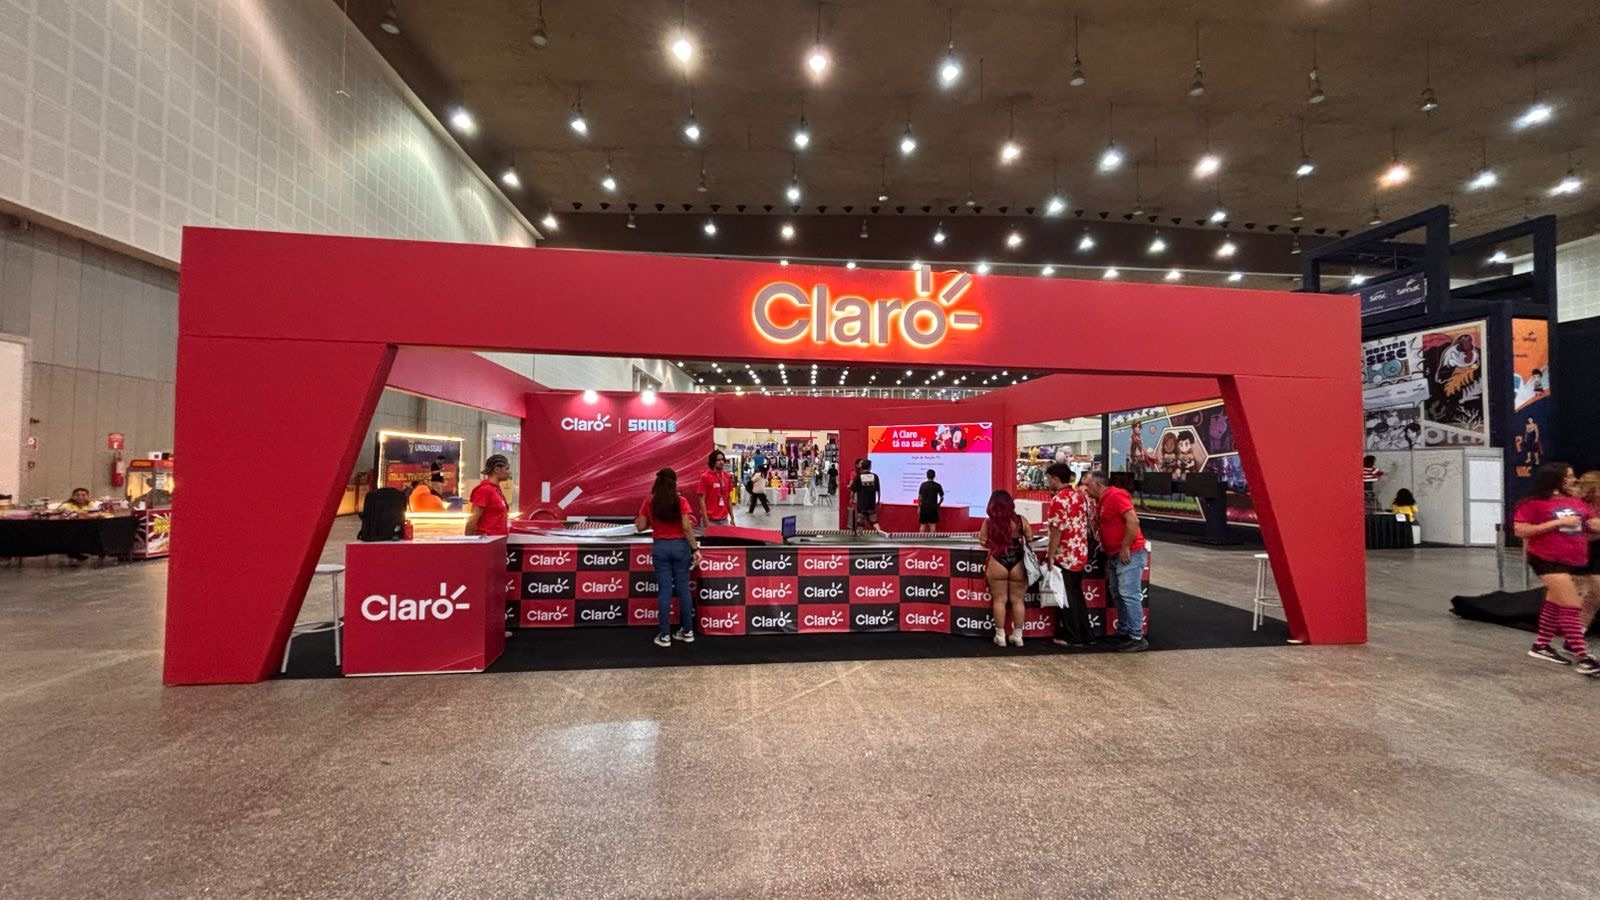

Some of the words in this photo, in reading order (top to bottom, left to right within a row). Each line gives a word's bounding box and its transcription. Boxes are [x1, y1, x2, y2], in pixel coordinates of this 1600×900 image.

[753, 282, 948, 347] Claro
[1366, 348, 1408, 366] SESC
[561, 417, 604, 432] Claro
[899, 430, 918, 438] Claro
[529, 555, 565, 566] Claro
[583, 554, 618, 565] Claro
[700, 559, 733, 571] Claro
[752, 559, 785, 570] Claro
[804, 558, 837, 570] Claro
[855, 558, 888, 569] Claro
[905, 559, 938, 570] Claro
[528, 582, 563, 594] Claro
[582, 582, 617, 593] Claro
[752, 587, 785, 598] Claro
[804, 586, 837, 598] Claro
[855, 586, 888, 597] Claro
[906, 586, 938, 597] Claro
[700, 588, 733, 600] Claro
[956, 589, 992, 602] Claro
[361, 594, 454, 621] Claro
[527, 610, 562, 621] Claro
[581, 609, 616, 620] Claro
[634, 608, 659, 619] Clar
[700, 617, 733, 628] Claro
[752, 616, 785, 627] Claro
[804, 615, 837, 626] Claro
[856, 614, 888, 625] Claro
[906, 614, 938, 625] Claro
[956, 617, 992, 630] Claro
